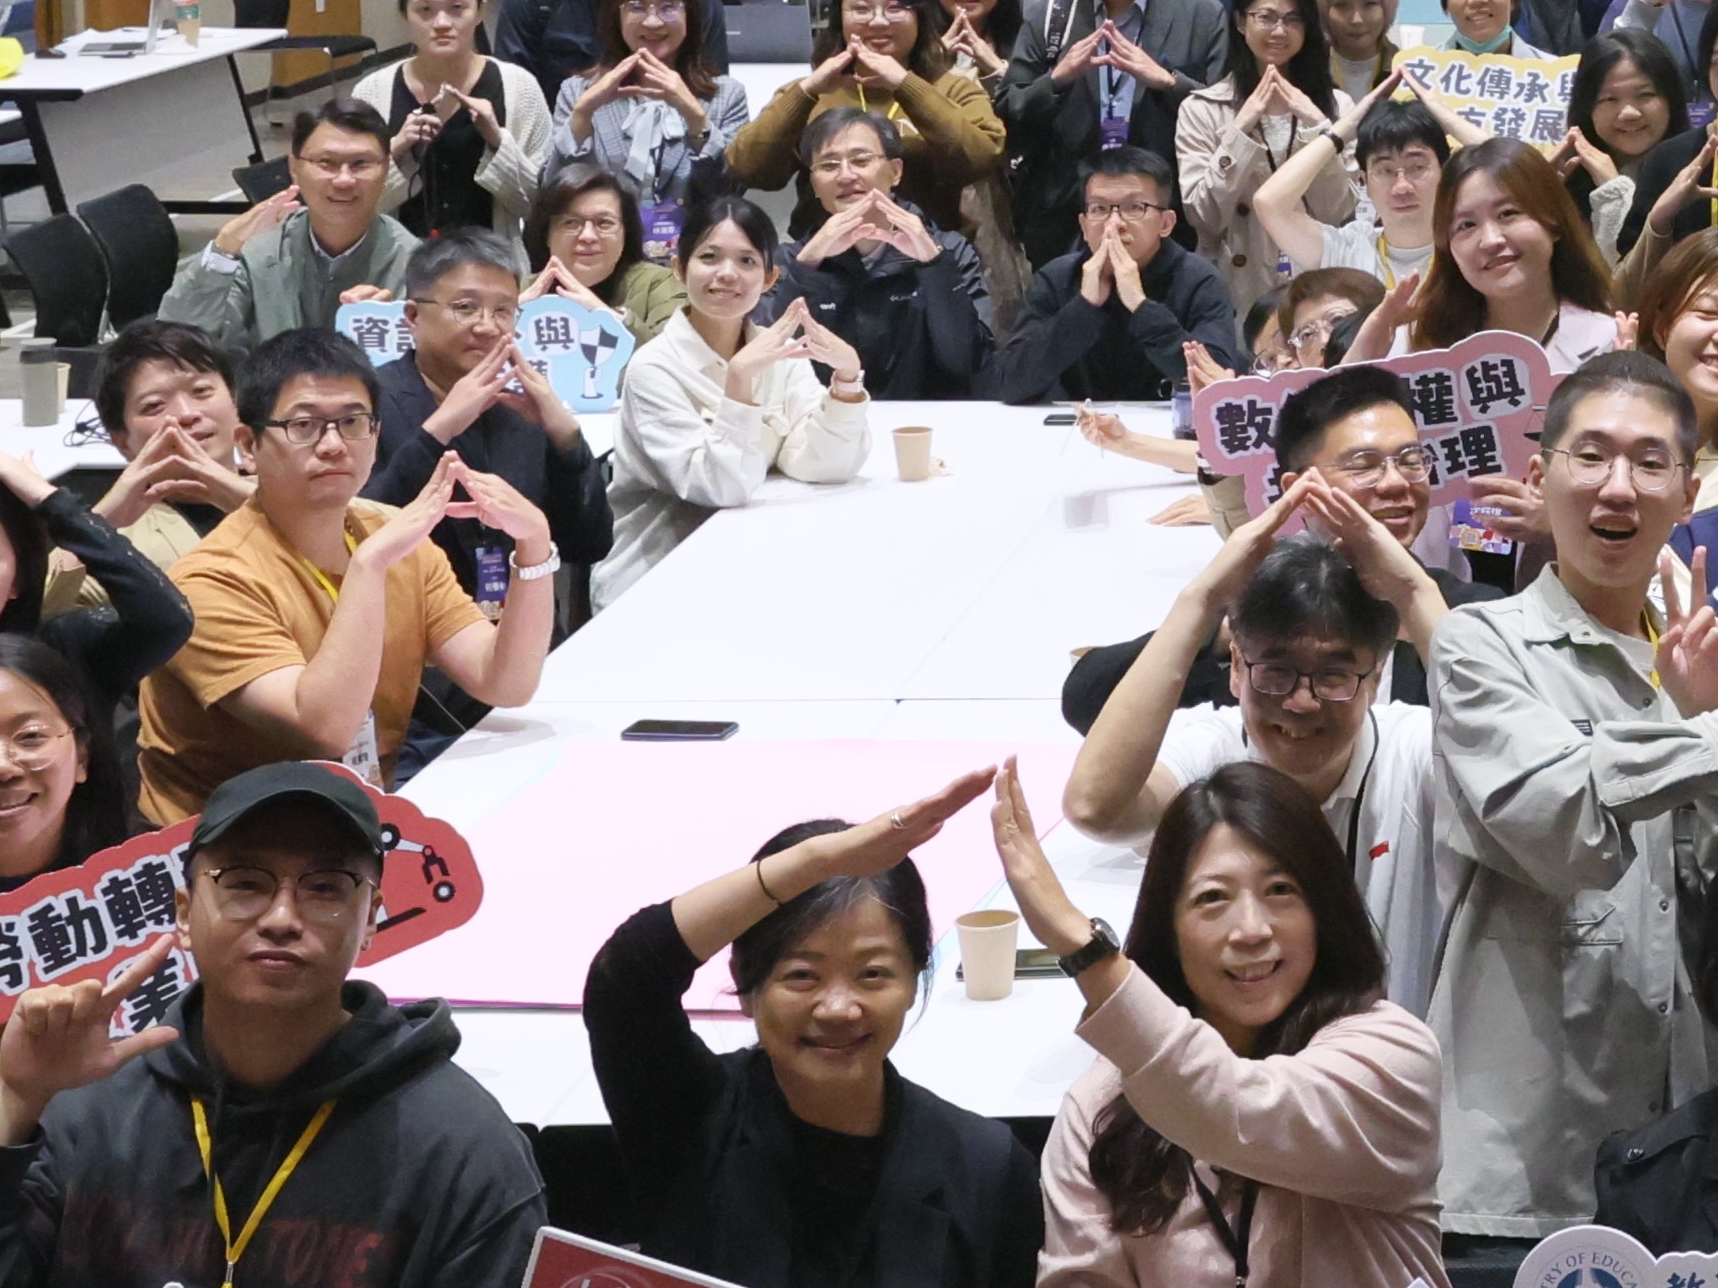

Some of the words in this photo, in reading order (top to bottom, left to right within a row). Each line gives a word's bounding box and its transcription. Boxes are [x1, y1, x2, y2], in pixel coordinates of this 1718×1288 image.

[1457, 107, 1568, 144] 方發展
[1565, 1251, 1587, 1269] OF
